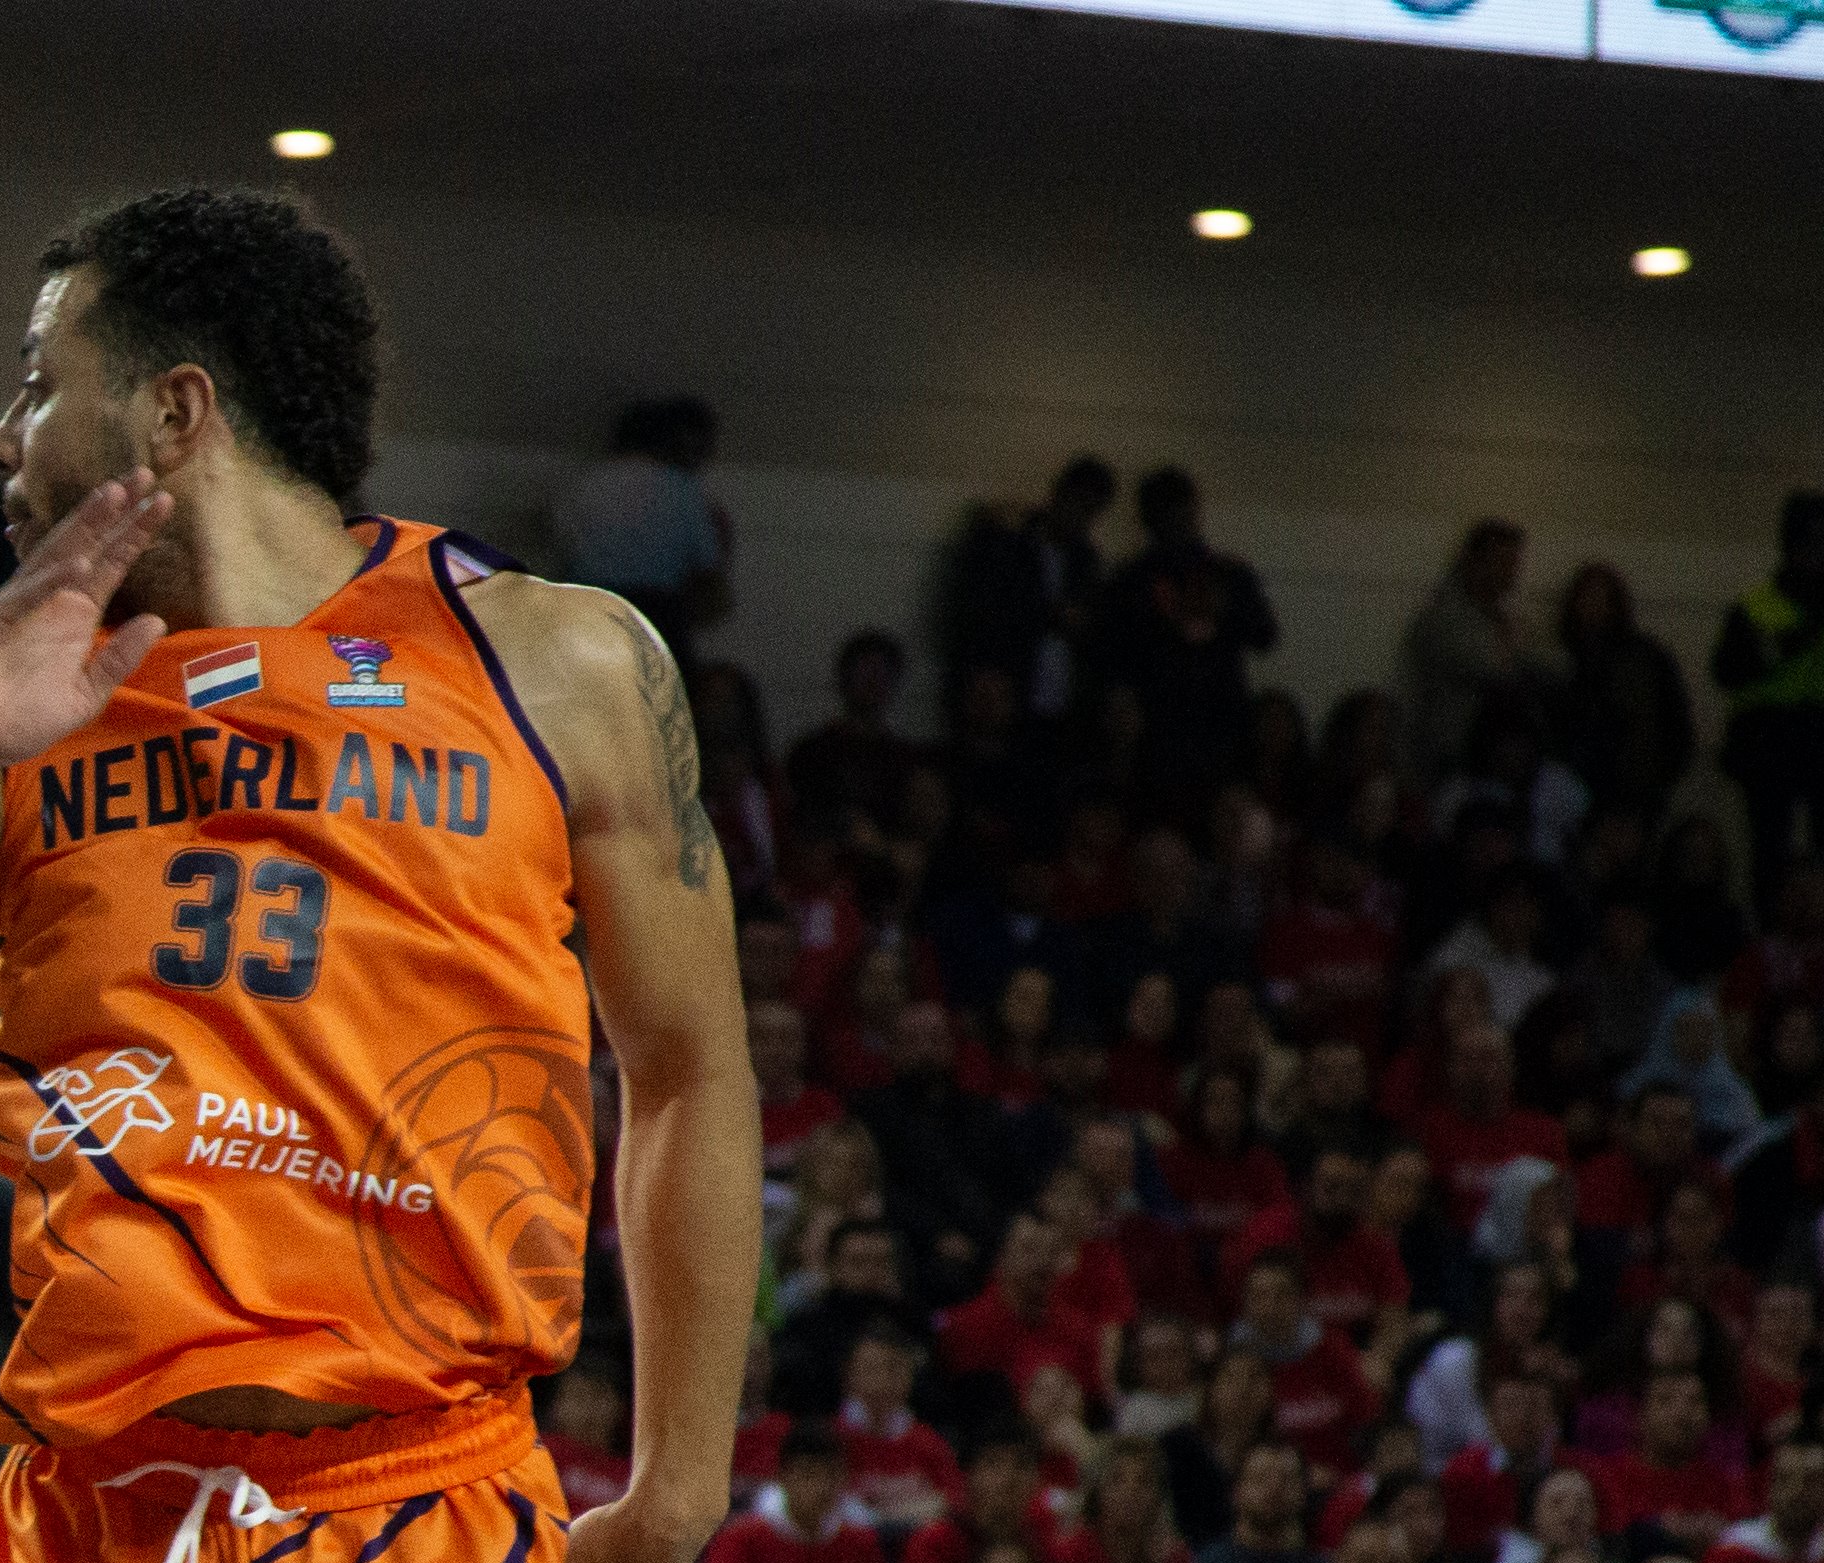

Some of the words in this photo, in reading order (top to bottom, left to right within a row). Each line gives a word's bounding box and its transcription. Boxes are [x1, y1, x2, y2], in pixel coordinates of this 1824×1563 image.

[39, 726, 491, 850] NEDERLAND
[152, 848, 330, 1002] 33
[196, 1091, 311, 1141] PAUL
[185, 1135, 433, 1213] MEIJERING
